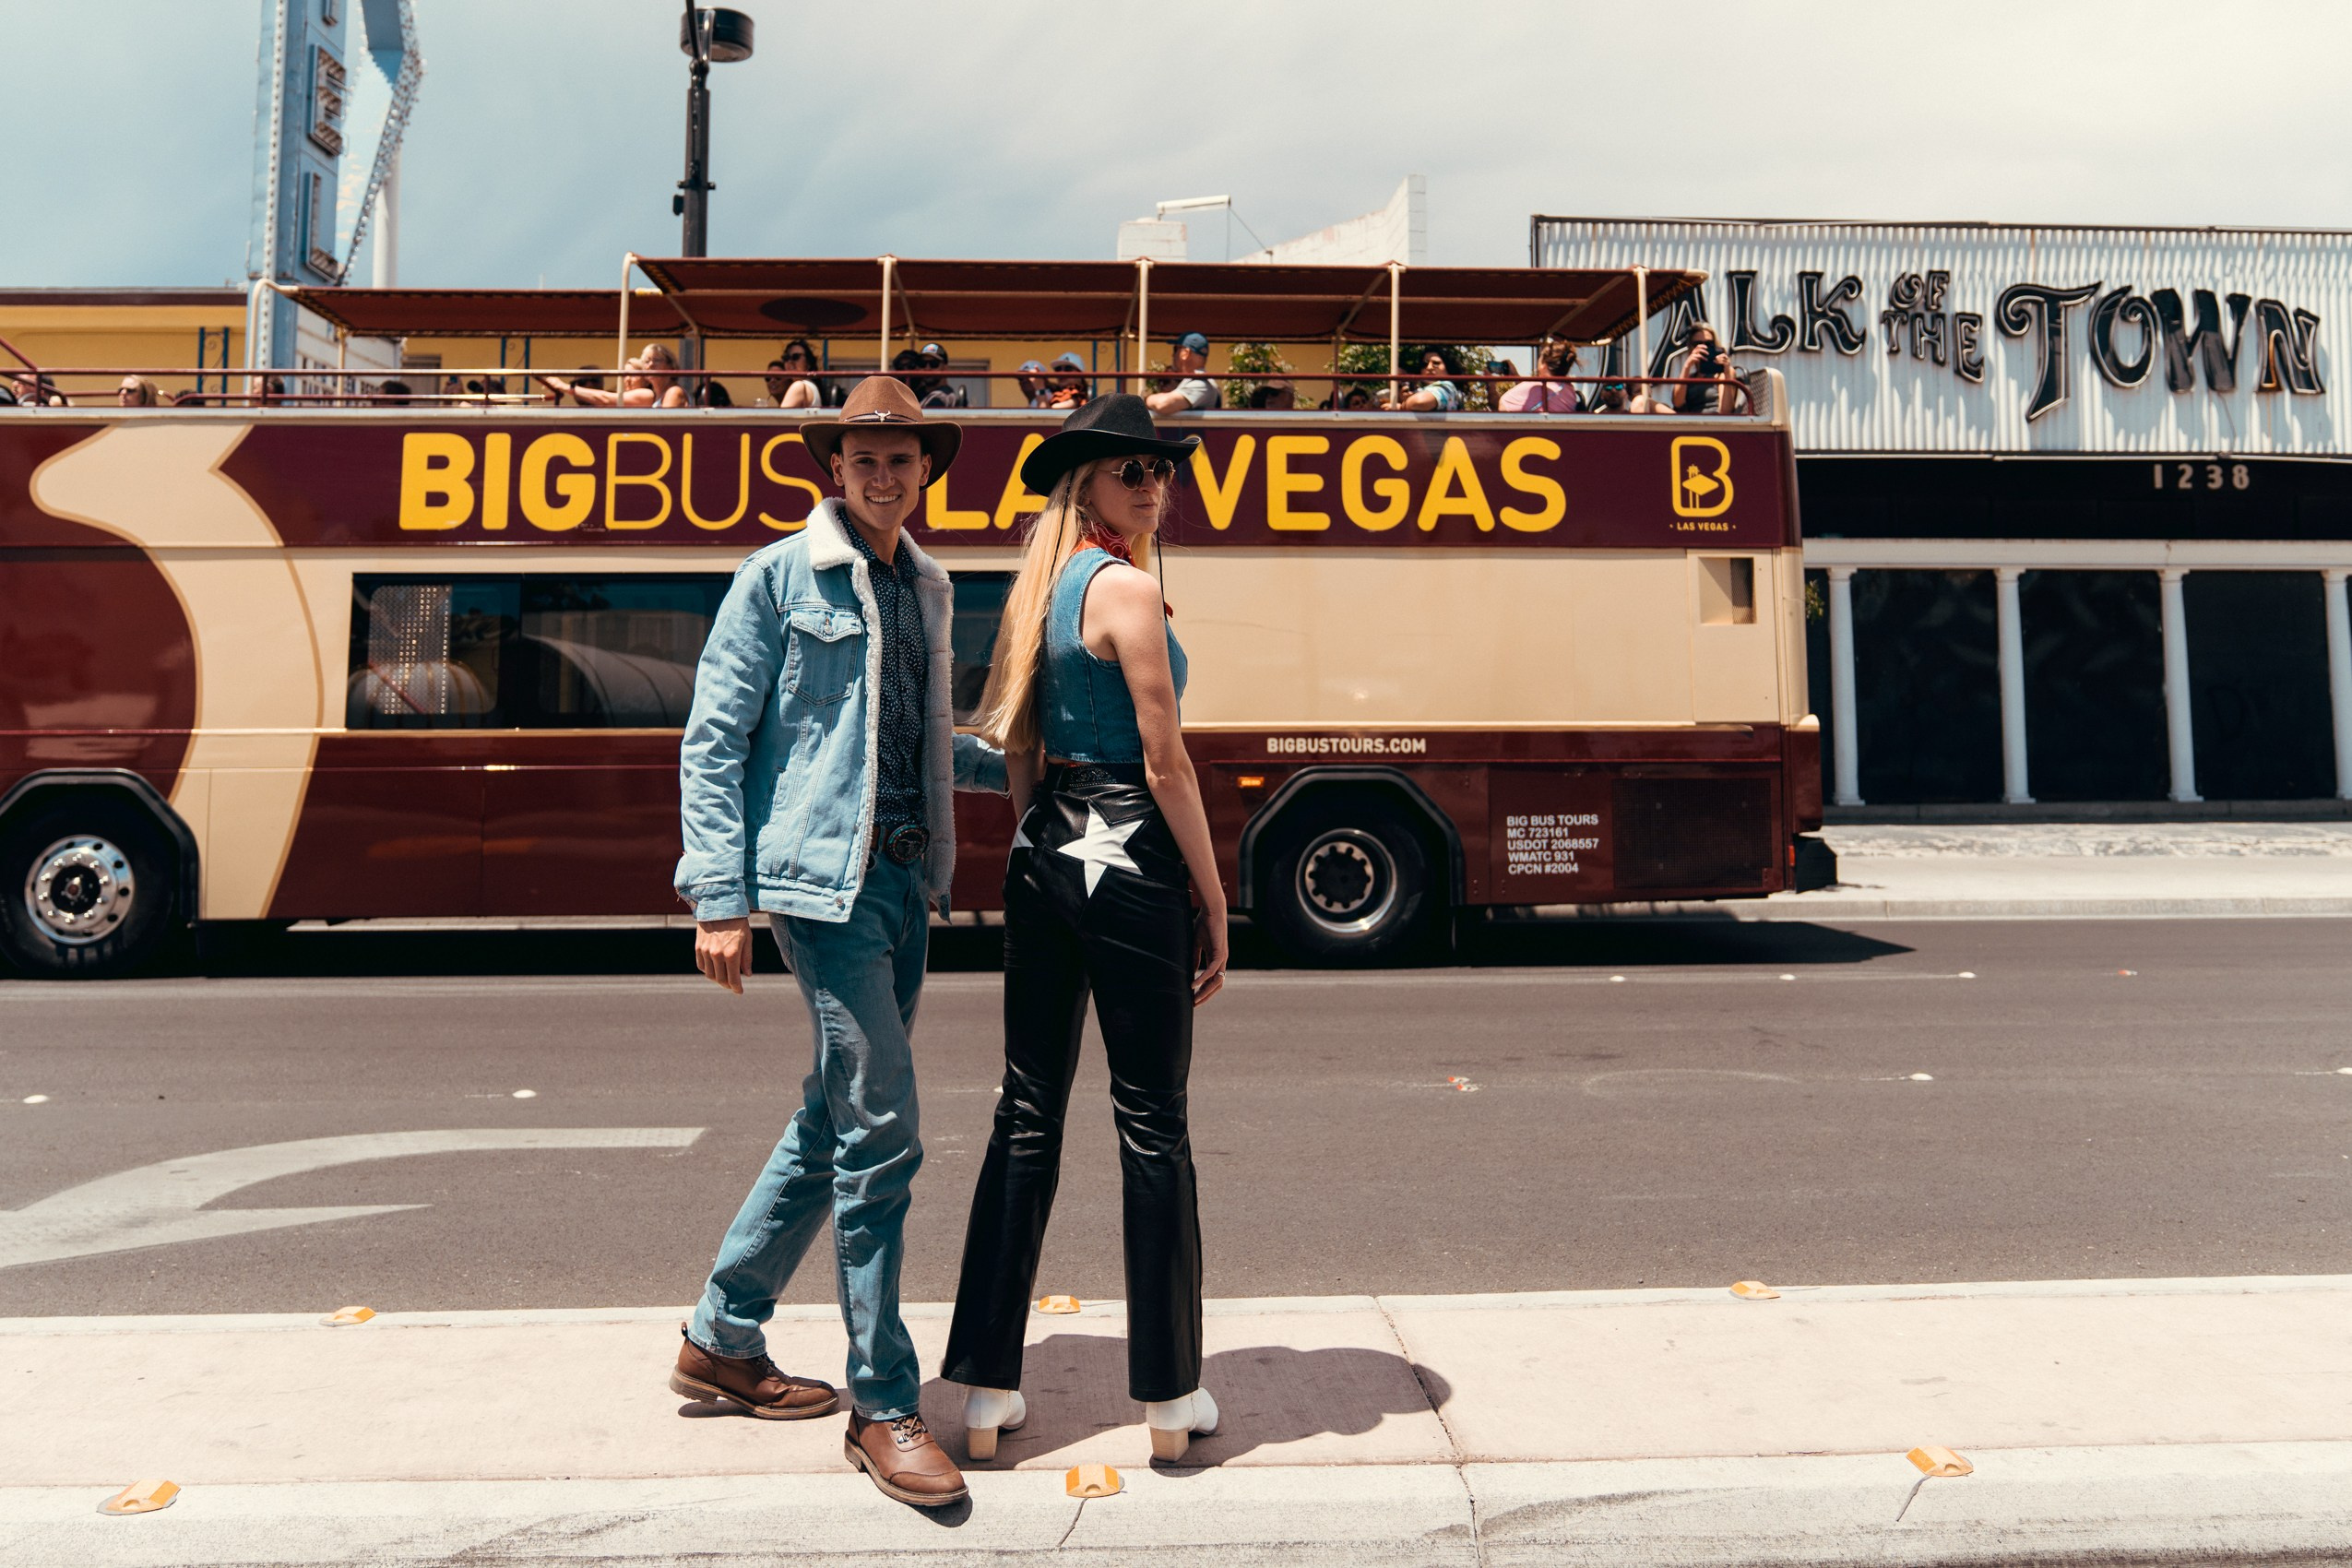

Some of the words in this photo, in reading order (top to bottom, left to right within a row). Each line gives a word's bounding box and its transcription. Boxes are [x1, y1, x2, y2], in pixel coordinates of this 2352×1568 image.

[1891, 270, 1951, 311] OF
[1882, 310, 1986, 384] THE
[1995, 280, 2326, 424] TOWN
[926, 433, 1049, 530] LA
[1187, 434, 1567, 532] VEGAS
[2154, 463, 2251, 490] 1238
[1676, 522, 1696, 531] LAS
[1697, 522, 1729, 531] VEGAS
[1266, 737, 1427, 754] BIGBUSTOURS.COM
[1506, 815, 1529, 827] BIG
[1530, 814, 1556, 826] BUS
[1557, 814, 1599, 826] TOURS
[1507, 827, 1526, 839] MC
[1527, 826, 1569, 838] 723161
[1507, 838, 1549, 850] USDOT
[1550, 837, 1599, 849] 2068557
[1507, 850, 1552, 862] WMATC
[1553, 849, 1574, 861] 931
[1508, 862, 1542, 874] CPCN
[1544, 862, 1579, 874] #2004
